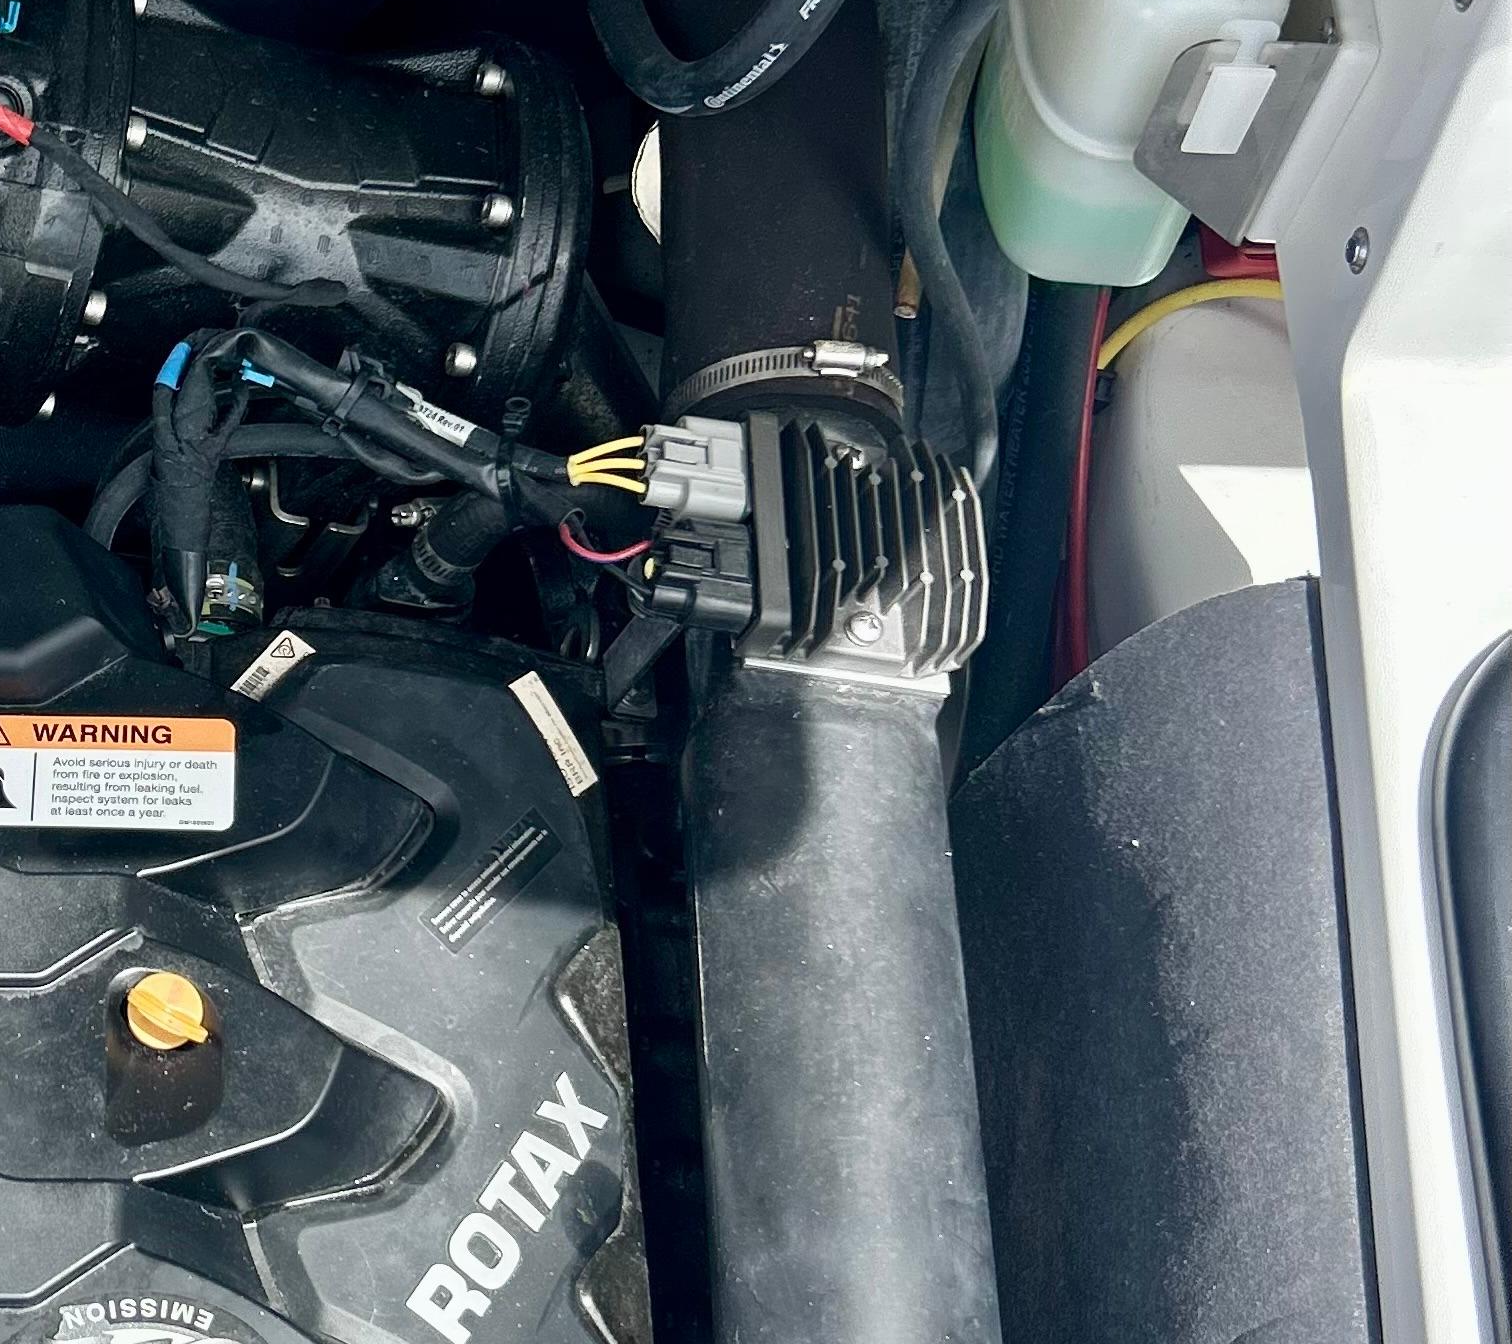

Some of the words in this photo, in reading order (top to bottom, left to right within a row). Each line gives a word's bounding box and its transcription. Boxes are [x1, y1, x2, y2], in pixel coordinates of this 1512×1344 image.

[32, 723, 172, 744] WARNING
[53, 758, 85, 767] Avoid
[89, 758, 130, 767] serious
[135, 759, 164, 770] injury
[169, 761, 181, 769] or
[185, 760, 217, 769] death
[53, 770, 78, 778] from
[83, 771, 100, 779] fire
[119, 771, 177, 782] explosion,
[52, 782, 100, 793] resulting
[105, 783, 130, 792] from
[135, 783, 175, 794] leaking
[51, 794, 94, 804] Inspect
[98, 796, 138, 805] system
[143, 796, 158, 804] for
[162, 796, 192, 805] leaks
[51, 807, 61, 815] at
[66, 807, 92, 816] least
[129, 809, 135, 817] a
[59, 1297, 216, 1331] EMISSION
